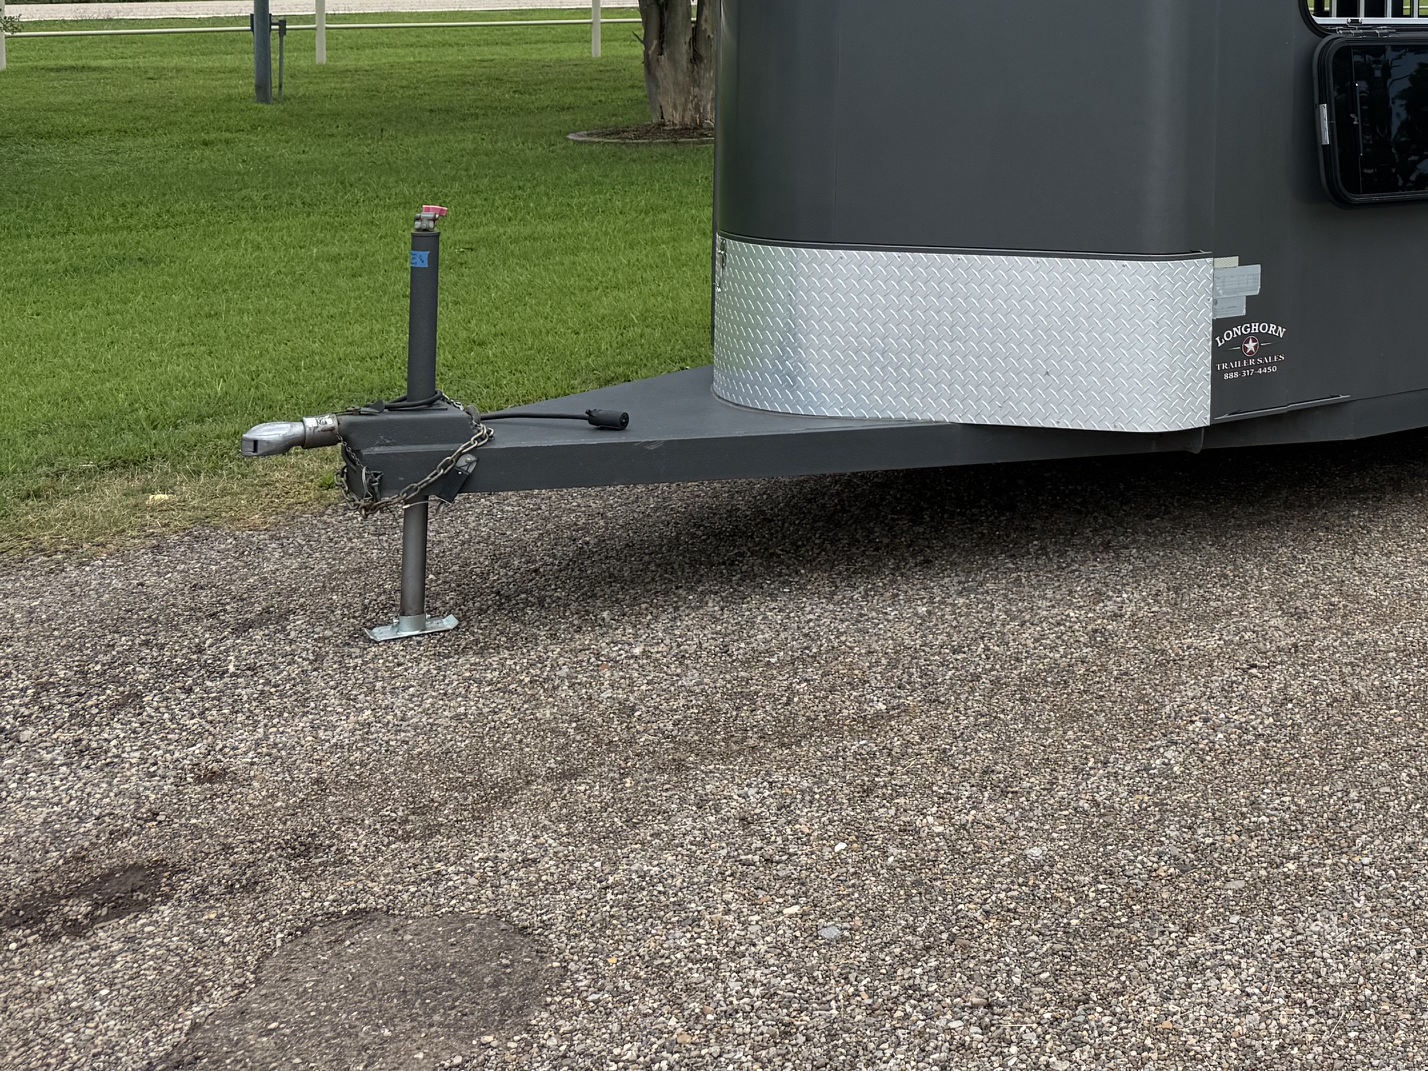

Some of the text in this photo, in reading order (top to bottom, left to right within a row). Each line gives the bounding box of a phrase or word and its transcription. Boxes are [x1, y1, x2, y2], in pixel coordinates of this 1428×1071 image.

[1215, 322, 1286, 347] LONGHORN
[1216, 353, 1285, 370] TRAILER SALES
[1223, 365, 1277, 380] 888-317-4450
